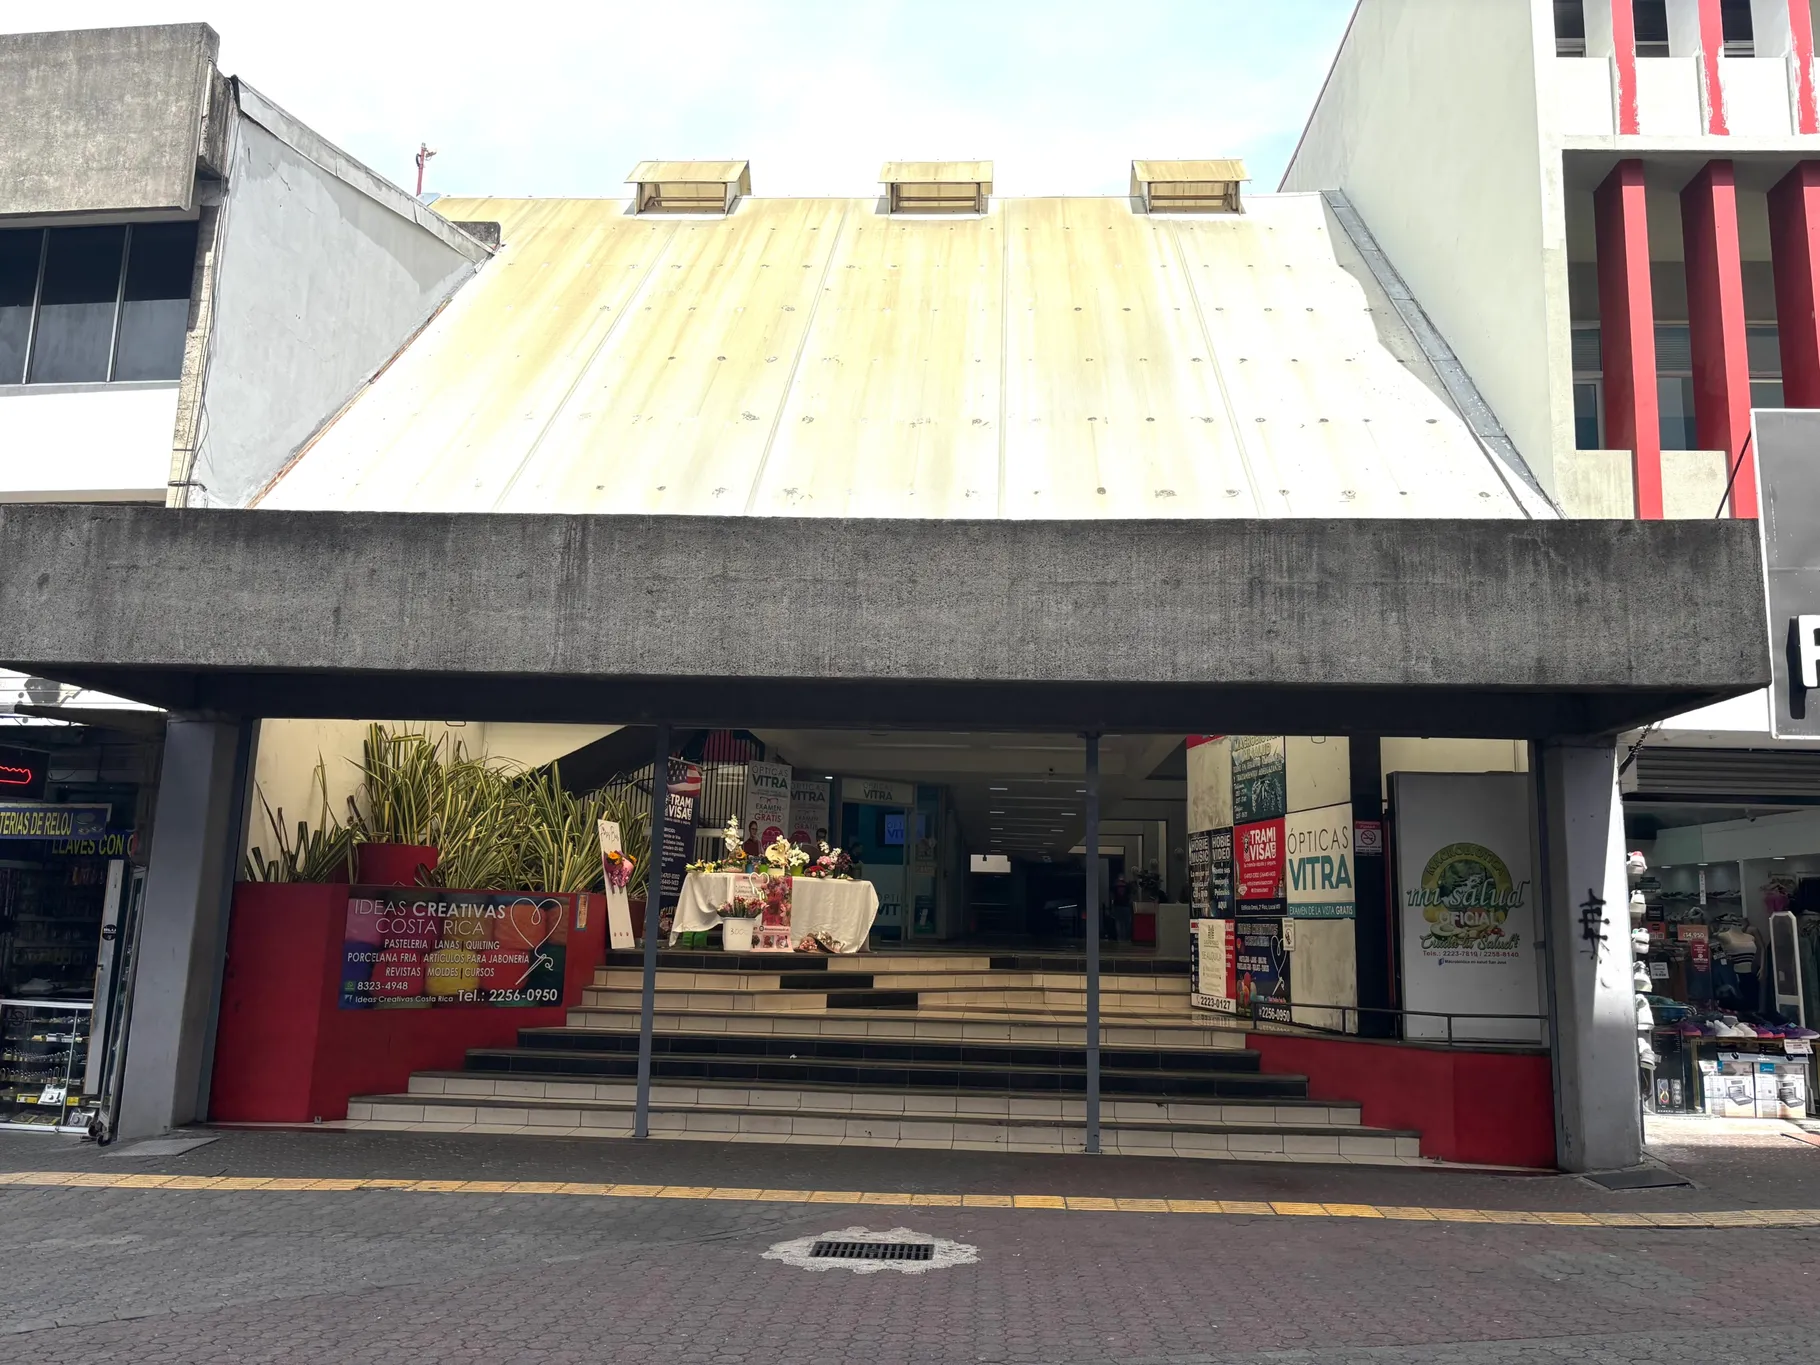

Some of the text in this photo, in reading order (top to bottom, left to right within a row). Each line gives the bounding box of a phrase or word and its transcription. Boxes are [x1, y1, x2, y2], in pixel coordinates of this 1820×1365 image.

[752, 774, 788, 789] VITRA
[670, 793, 694, 809] TRAMI
[790, 790, 825, 802] VITRA
[864, 789, 893, 801] VITRA
[756, 803, 782, 812] EXAMEN
[30, 812, 43, 835] DE
[44, 812, 74, 836] RELOJ
[755, 813, 782, 823] GRATIS
[1250, 827, 1276, 844] TRAMI
[1287, 826, 1349, 854] ÓPTICAS
[99, 834, 124, 856] CON
[1249, 843, 1273, 861] VISA
[1288, 854, 1352, 891] VITRA
[1407, 878, 1530, 908] mi salud
[354, 899, 506, 920] IDEAS CREATIVAS
[1289, 906, 1308, 916] EXAMEN
[1308, 906, 1315, 915] DE
[1315, 906, 1321, 915] LA
[1322, 905, 1336, 915] VISTA
[1335, 905, 1353, 915] GRATIS
[1439, 910, 1499, 926] OFICIAL
[375, 916, 485, 935] COSTA RICA
[384, 938, 500, 951] PASTELERIA LANAS QUILTING
[347, 951, 530, 964] PORCELANA FRIA ARTÍCULOS PARA JABONERÍA
[385, 967, 495, 978] REVISTAS MOLDES CURSOS
[356, 981, 408, 991] 8323-4948
[355, 995, 454, 1003] Ideas Creativas Costa Rica
[458, 988, 559, 1002] Tel.: 2256-0950
[1200, 996, 1231, 1010] 2223-0127
